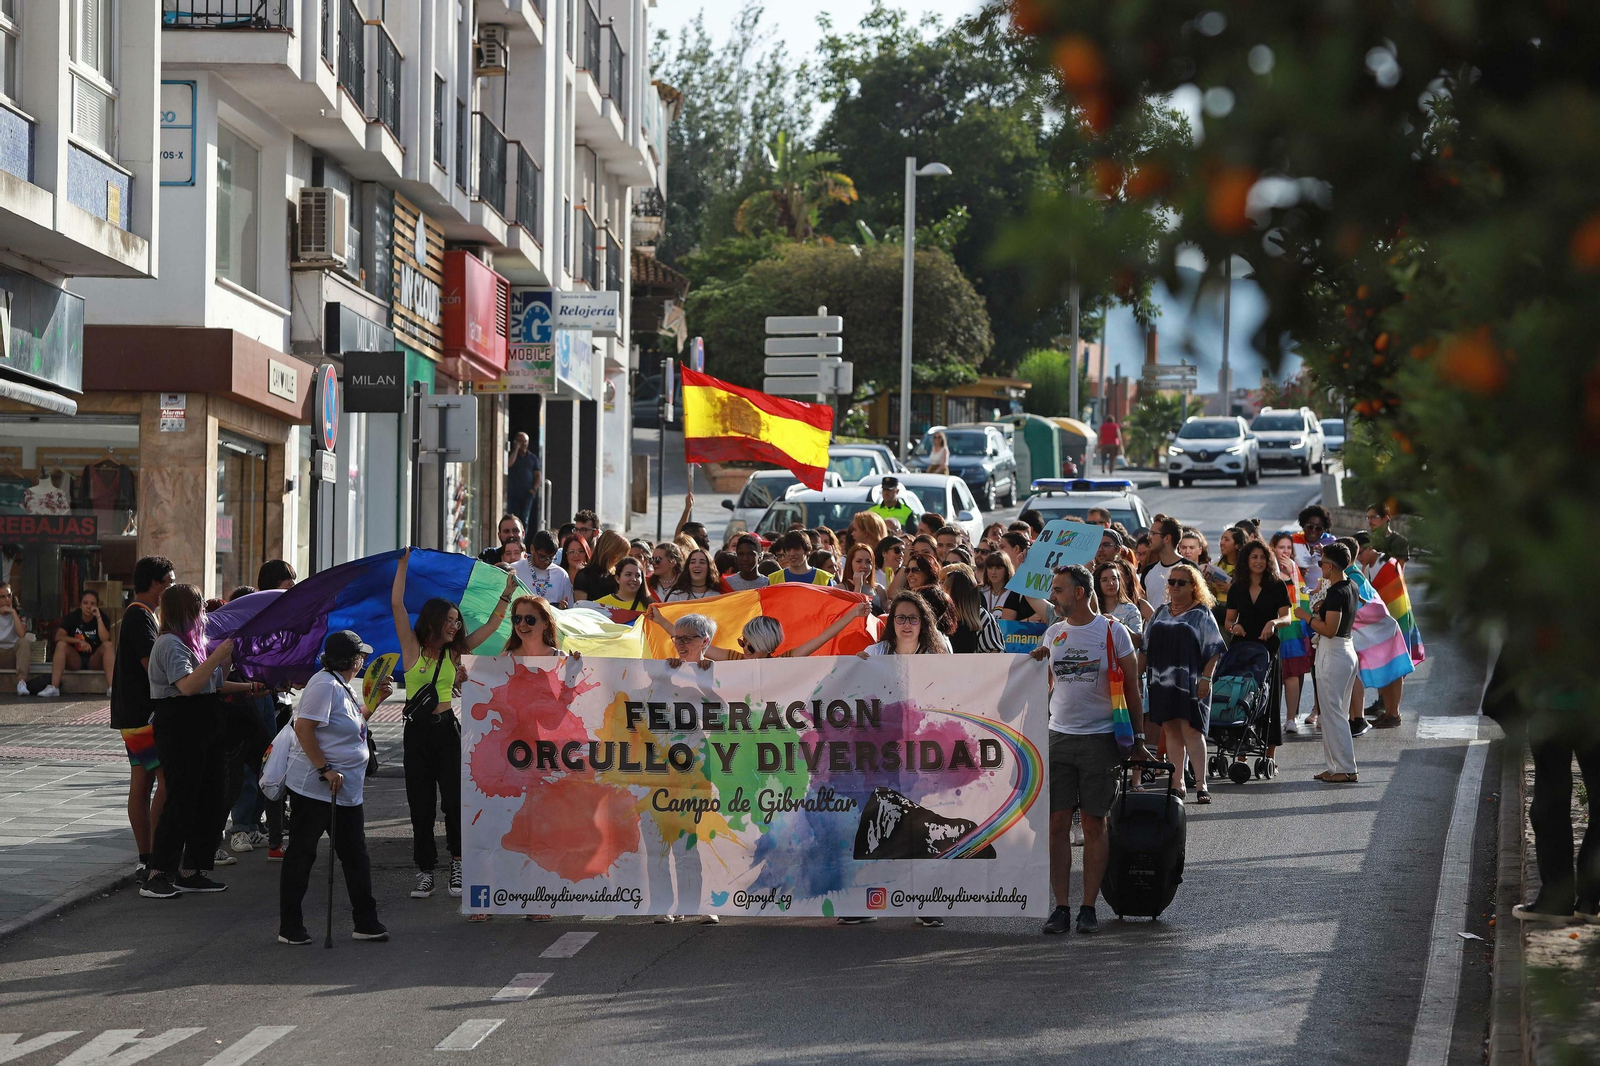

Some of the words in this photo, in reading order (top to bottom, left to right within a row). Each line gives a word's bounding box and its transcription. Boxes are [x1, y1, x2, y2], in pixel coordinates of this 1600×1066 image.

[414, 271, 440, 326] CLOUD
[559, 305, 615, 318] Relojería
[356, 316, 380, 352] MILAN
[511, 292, 522, 343] LVEZ
[352, 375, 396, 385] MILAN
[624, 699, 883, 732] FEDERACION
[507, 740, 696, 773] ORGULLO
[711, 742, 741, 773] Y
[756, 738, 1004, 773] DIVERSIDAD
[652, 788, 720, 824] Campo
[727, 786, 750, 812] de
[757, 785, 857, 824] Gibraltar
[493, 886, 643, 909] @orgulloydiversidadCG
[733, 887, 792, 910] @poyd_cg
[891, 886, 1028, 910] @orgulloydiversidadcg
